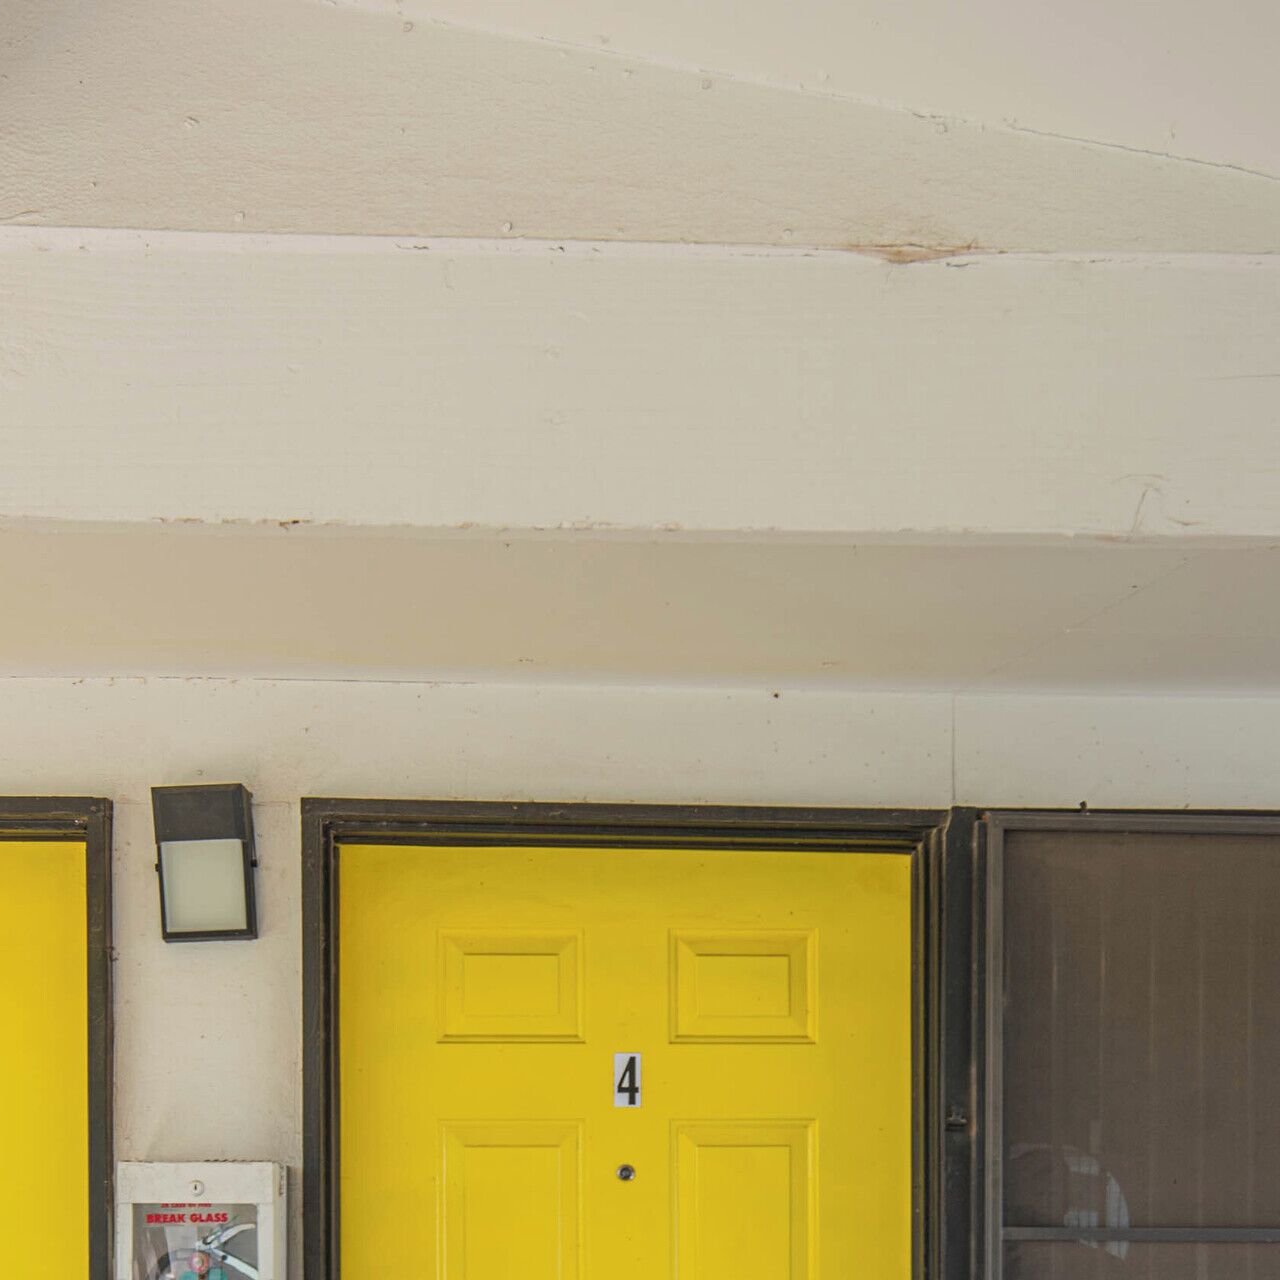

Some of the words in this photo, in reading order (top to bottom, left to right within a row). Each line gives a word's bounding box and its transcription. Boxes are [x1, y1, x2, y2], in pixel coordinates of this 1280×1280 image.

[617, 1056, 639, 1105] 4
[146, 1213, 186, 1224] BREAK
[190, 1212, 228, 1223] GLASS
